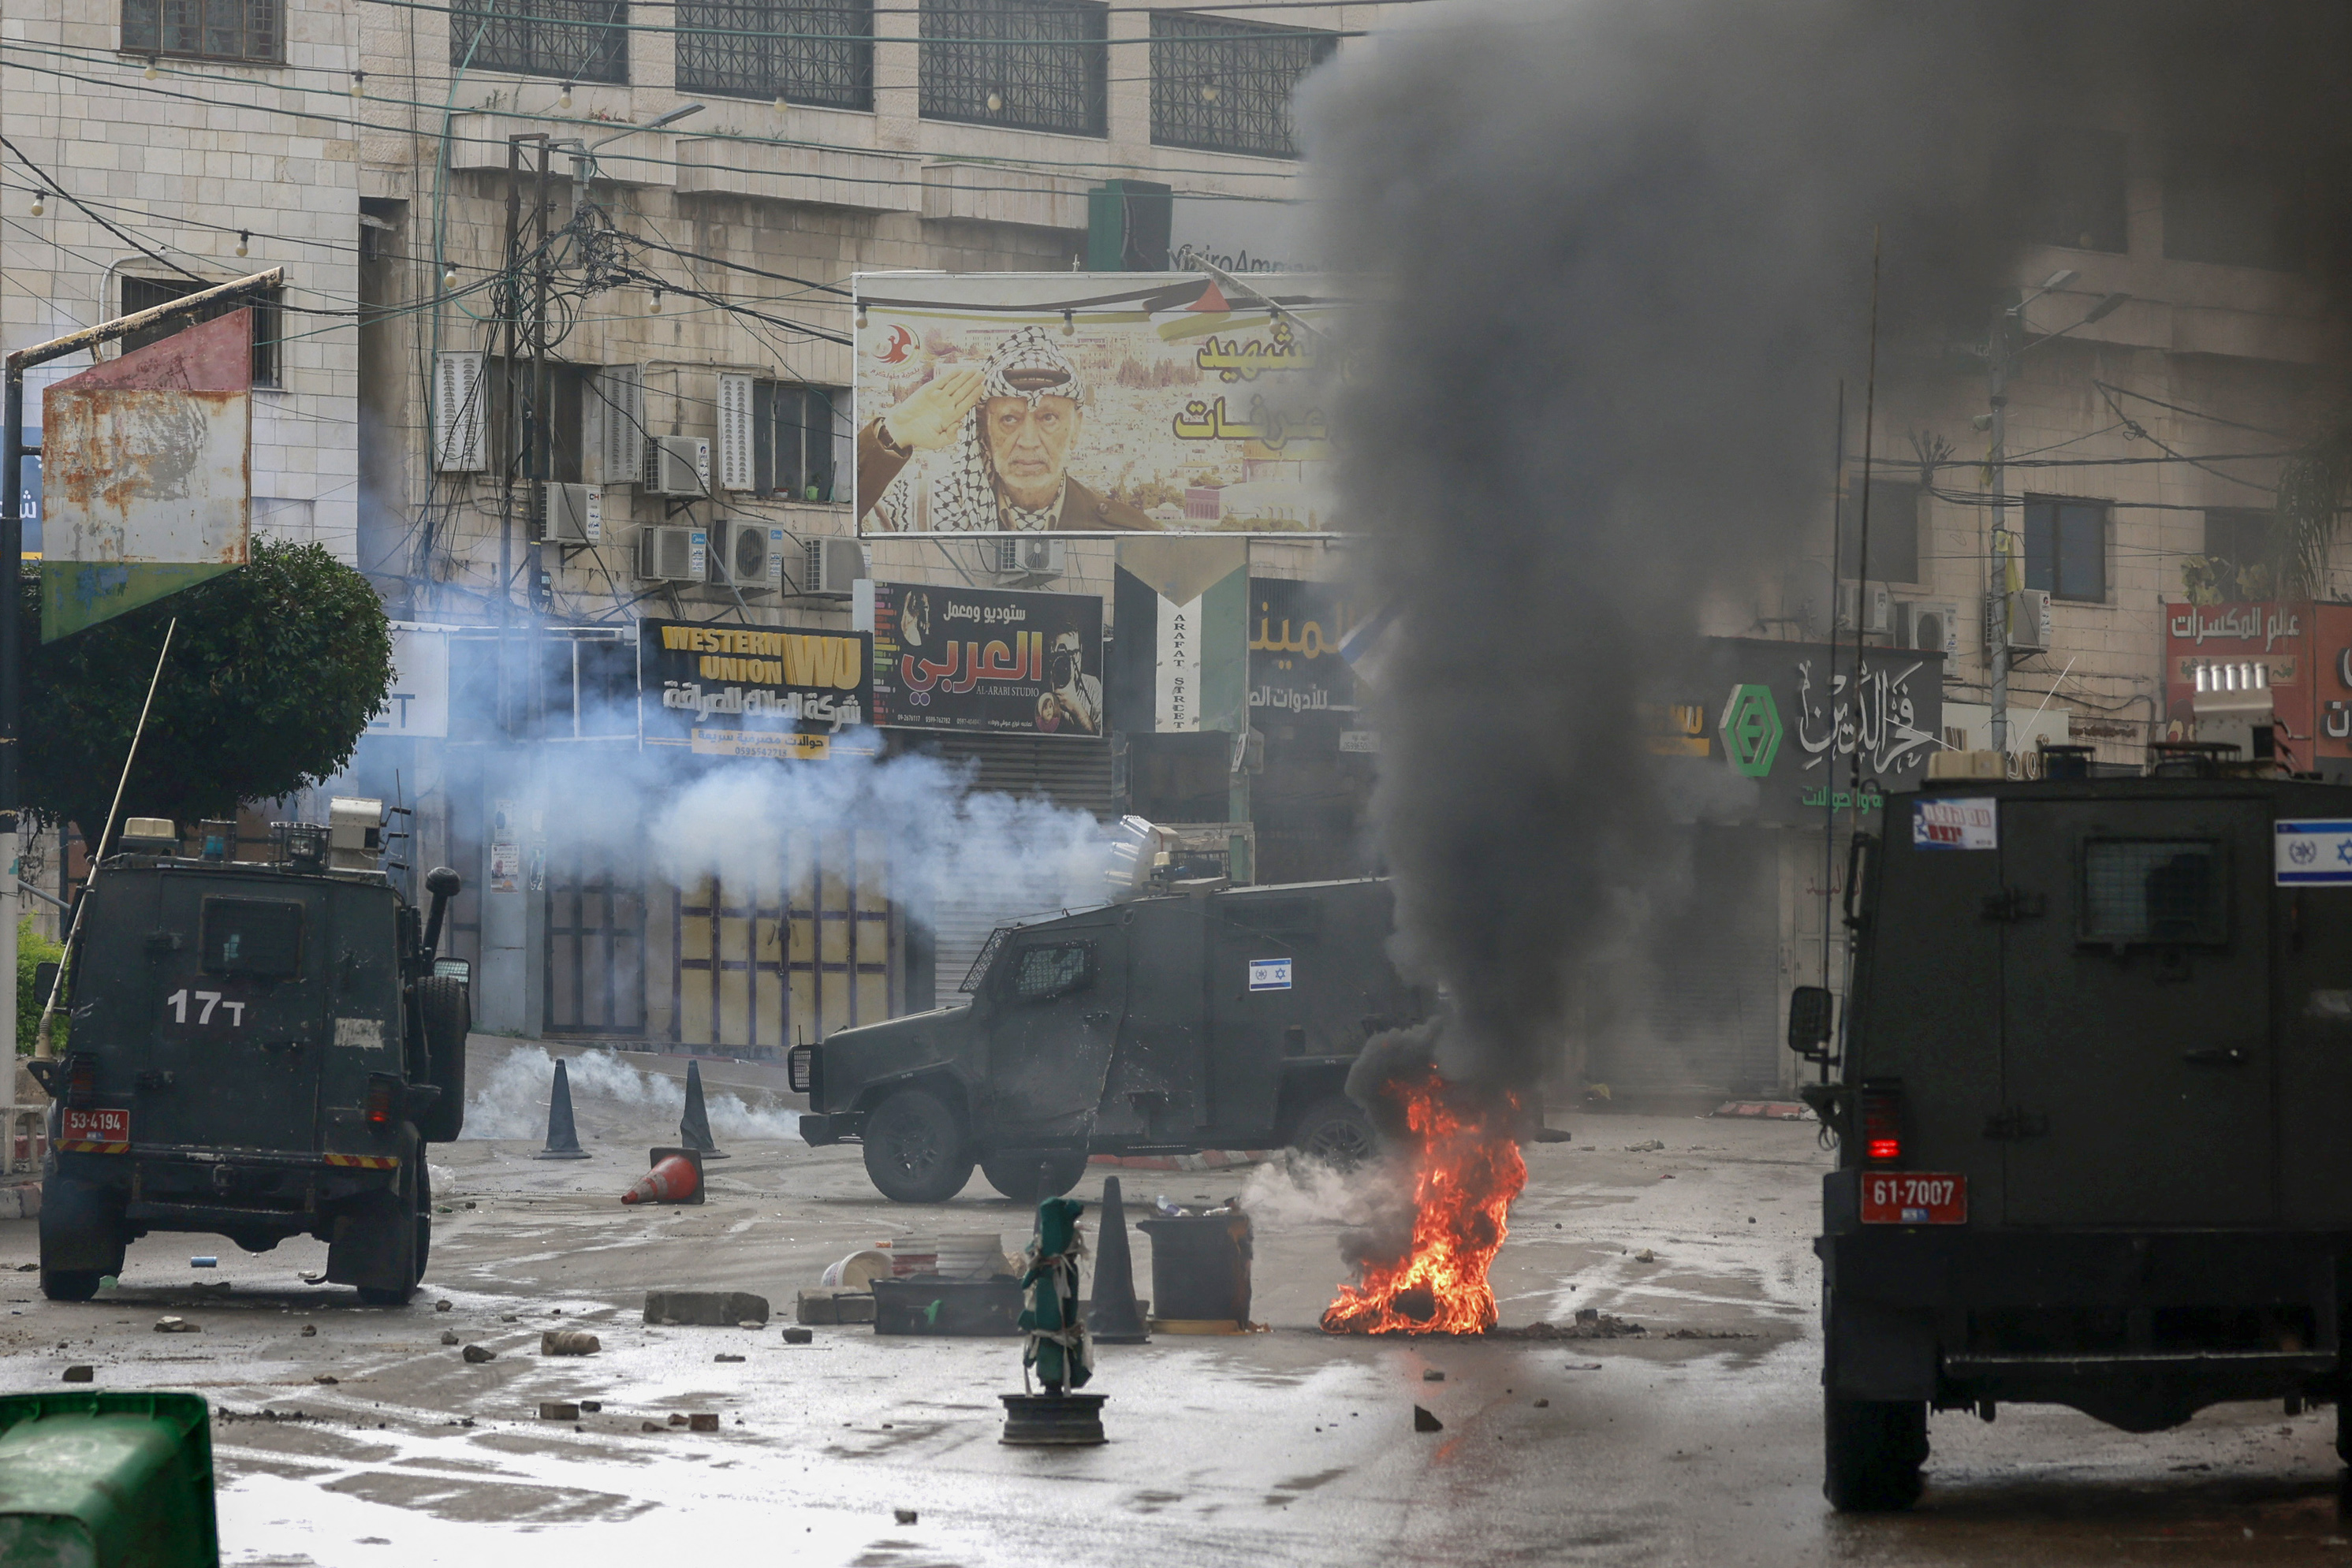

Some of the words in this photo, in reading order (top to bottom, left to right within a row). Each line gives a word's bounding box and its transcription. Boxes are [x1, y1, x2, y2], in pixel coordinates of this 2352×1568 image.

[943, 601, 981, 622] ومعمل
[985, 604, 1026, 625] ستوديو
[1172, 614, 1186, 667] ARAFAT
[662, 626, 782, 657] WESTERN
[781, 633, 862, 691] WU
[699, 655, 783, 685] UNION
[901, 631, 1043, 706] العربي
[976, 685, 1010, 696] AL-ARABI
[1011, 687, 1040, 698] STUDIO
[803, 693, 862, 733] شركة
[785, 735, 824, 749] حوالات
